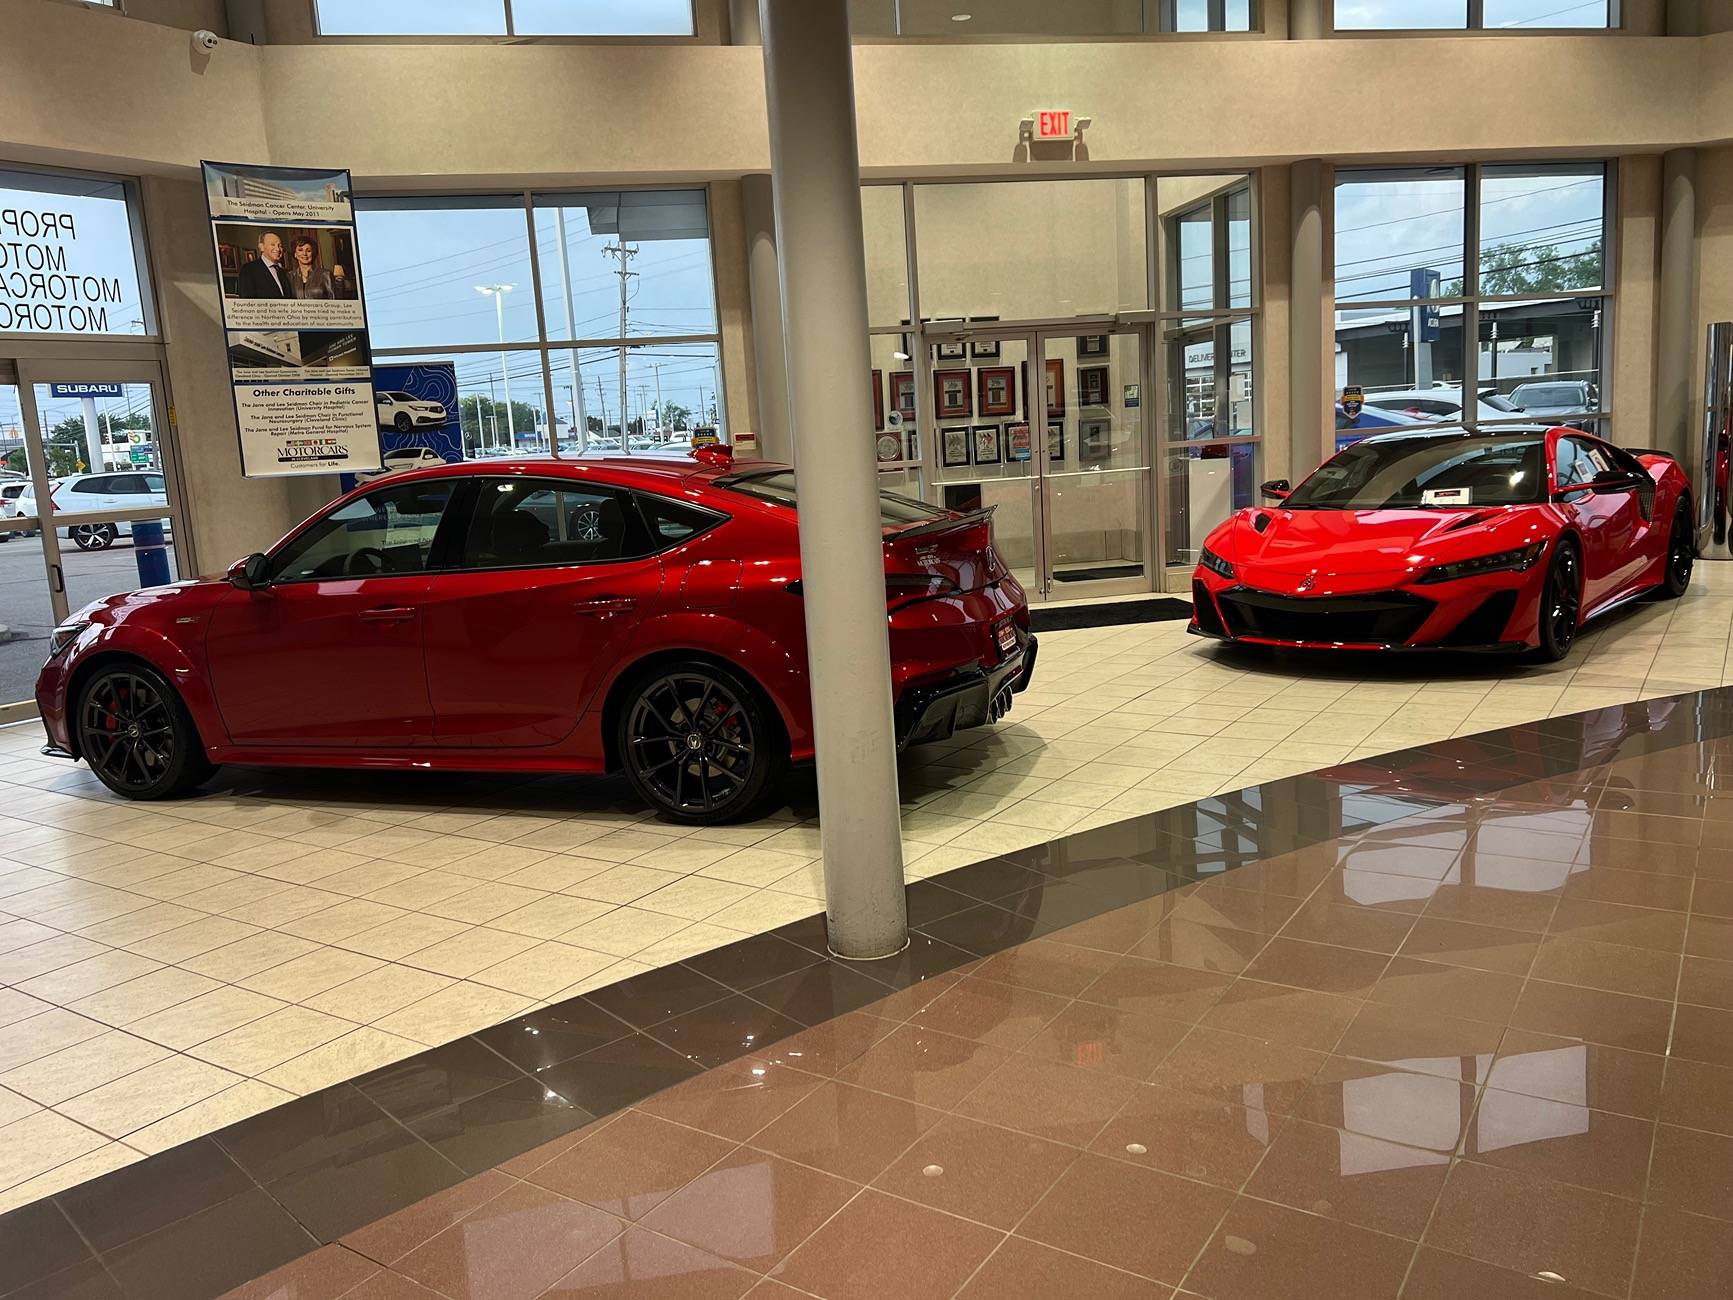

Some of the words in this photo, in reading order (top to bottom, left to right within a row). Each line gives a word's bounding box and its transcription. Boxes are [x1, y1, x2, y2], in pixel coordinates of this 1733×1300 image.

[1040, 111, 1069, 136] EXIT
[1188, 352, 1214, 363] DELIVER
[57, 384, 118, 392] SUBARU
[253, 389, 280, 397] Other
[283, 388, 331, 396] Charitable
[277, 446, 349, 457] MOTORCARS
